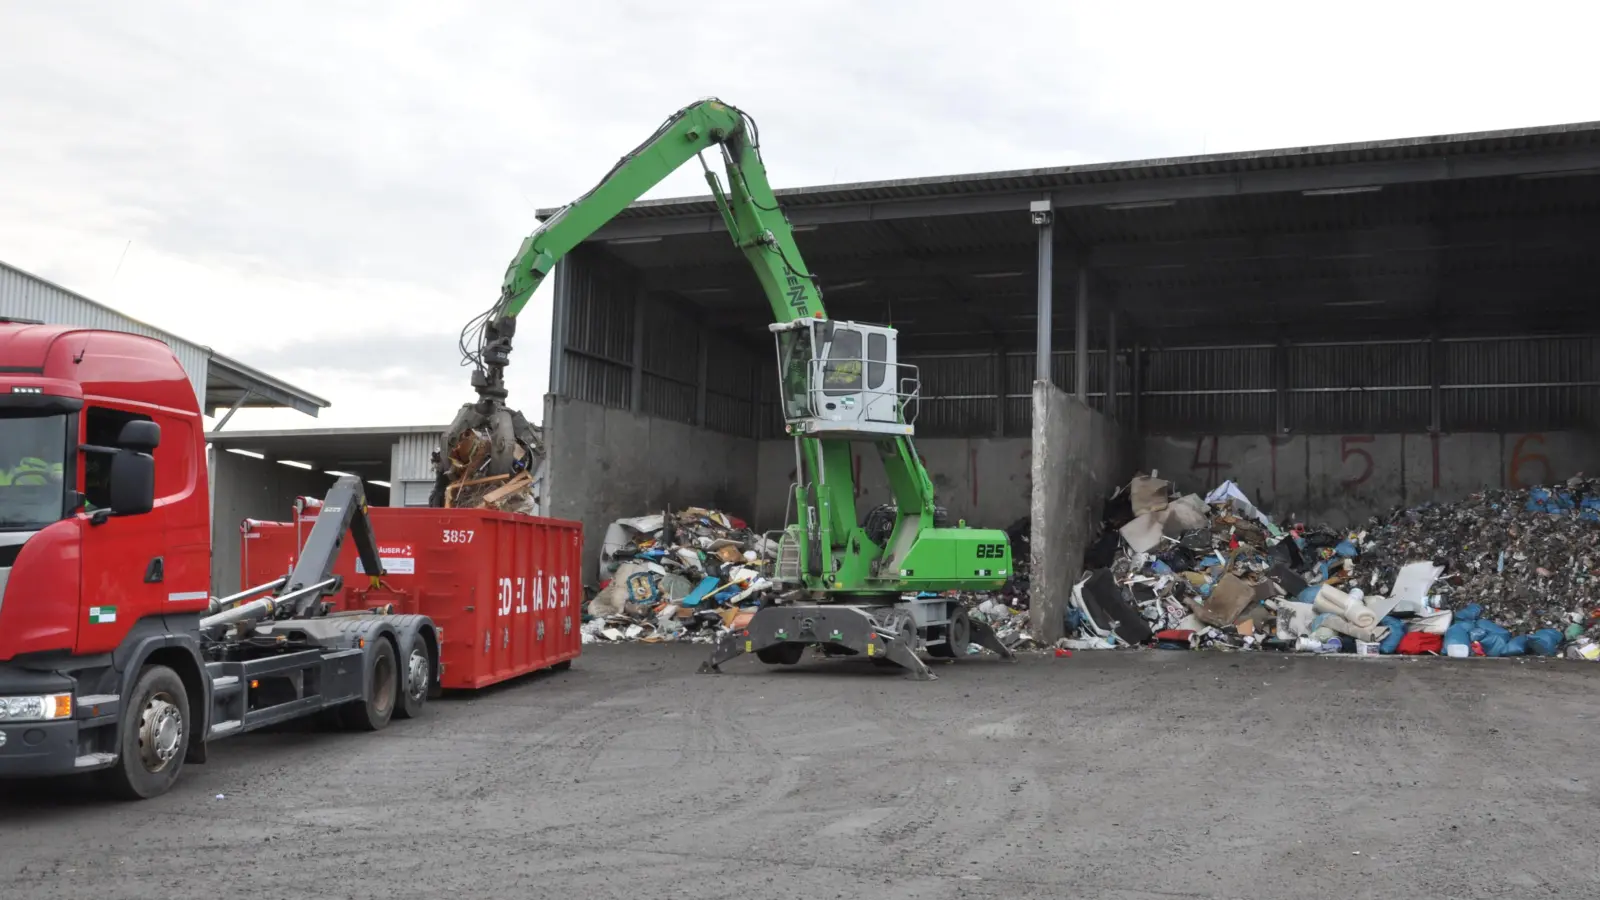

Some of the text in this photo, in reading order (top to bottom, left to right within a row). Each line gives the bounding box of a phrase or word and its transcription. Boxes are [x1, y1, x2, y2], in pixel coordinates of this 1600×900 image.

[1190, 434, 1232, 488] 4
[1340, 435, 1375, 489] 5
[1510, 433, 1552, 489] 6
[442, 529, 475, 544] 3857
[976, 544, 1005, 558] 825
